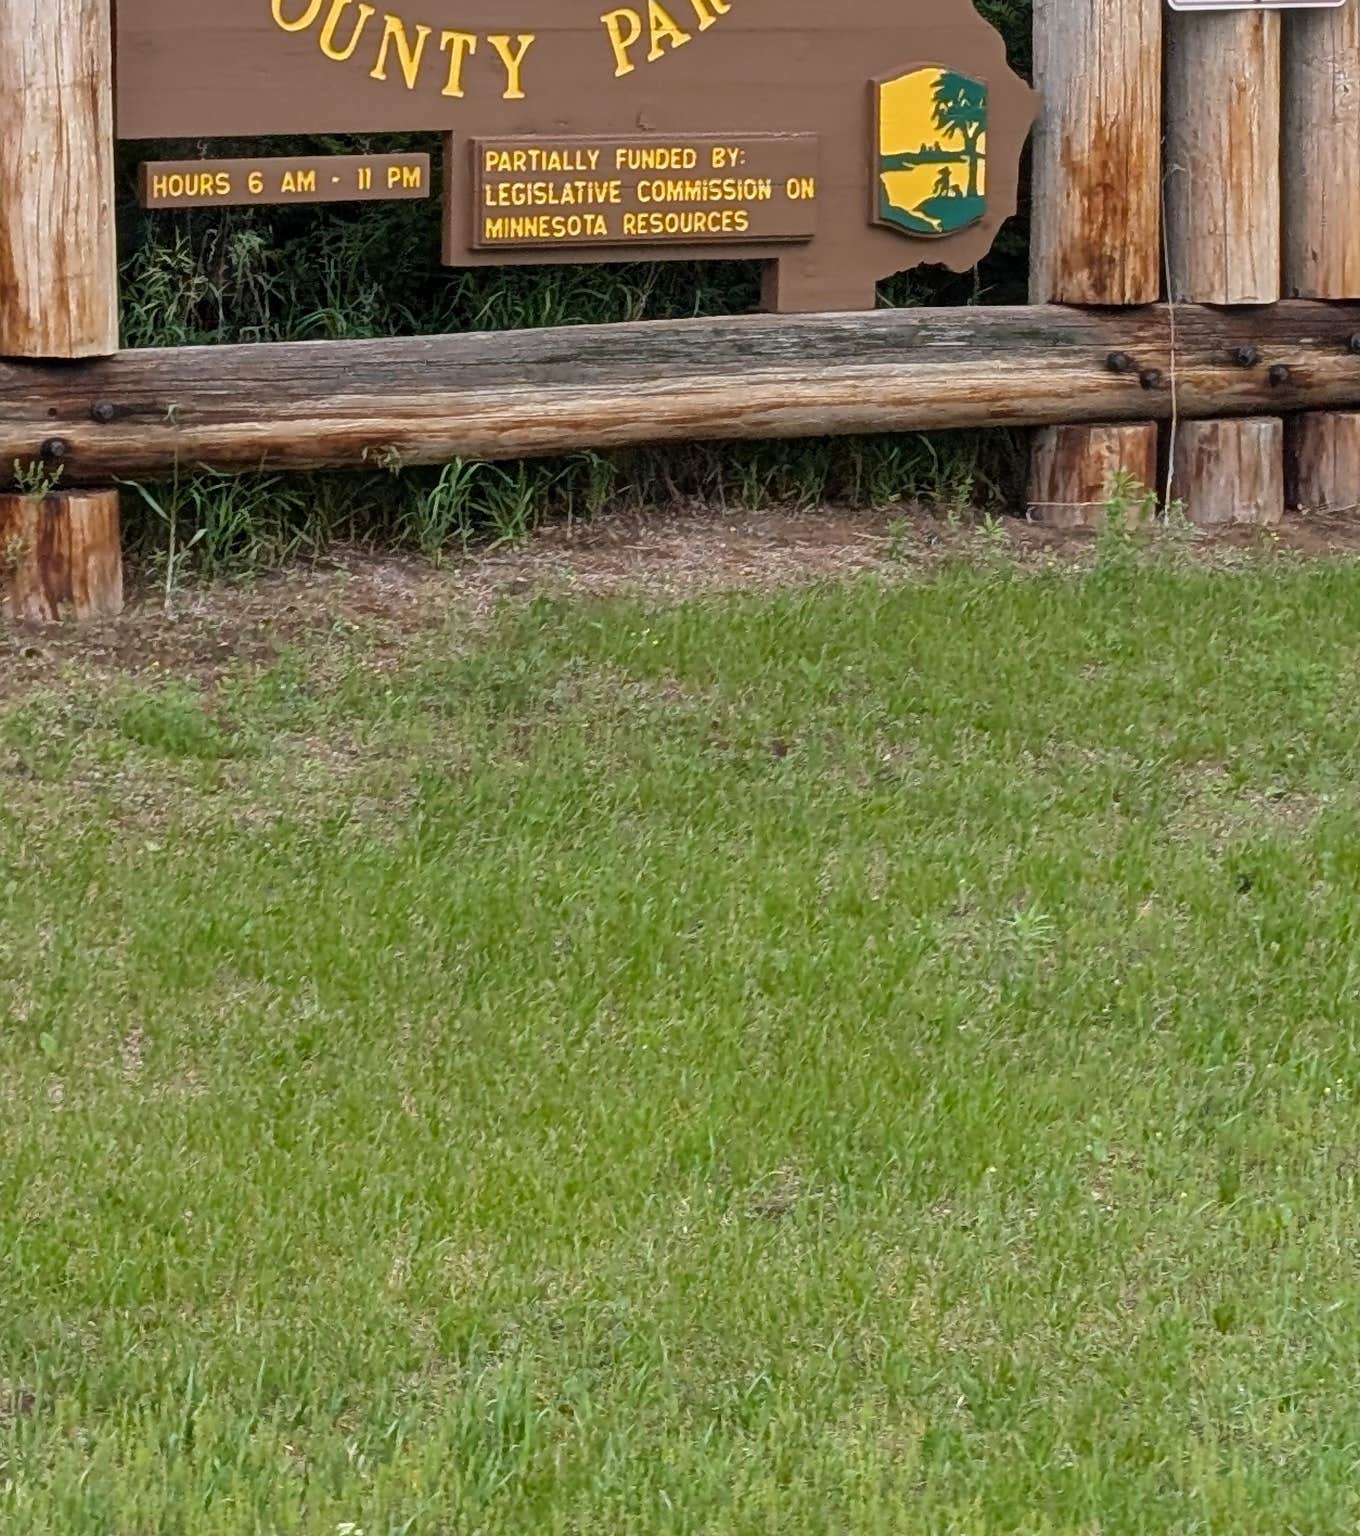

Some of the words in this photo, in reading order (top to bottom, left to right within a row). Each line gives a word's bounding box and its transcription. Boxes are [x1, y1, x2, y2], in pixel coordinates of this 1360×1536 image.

[485, 148, 600, 172] PARTIALLY
[615, 146, 699, 170] FUNDED
[711, 145, 746, 168] BY:
[151, 170, 232, 198] HOURS
[246, 169, 264, 194] 6
[280, 168, 318, 193] AM
[386, 164, 422, 190] PM
[485, 180, 622, 206] LEGISLATIVE
[636, 178, 772, 202] COMMISSION
[786, 177, 816, 200] ON
[485, 212, 608, 238] MINNESOTA
[623, 209, 749, 234] RESOURCES
